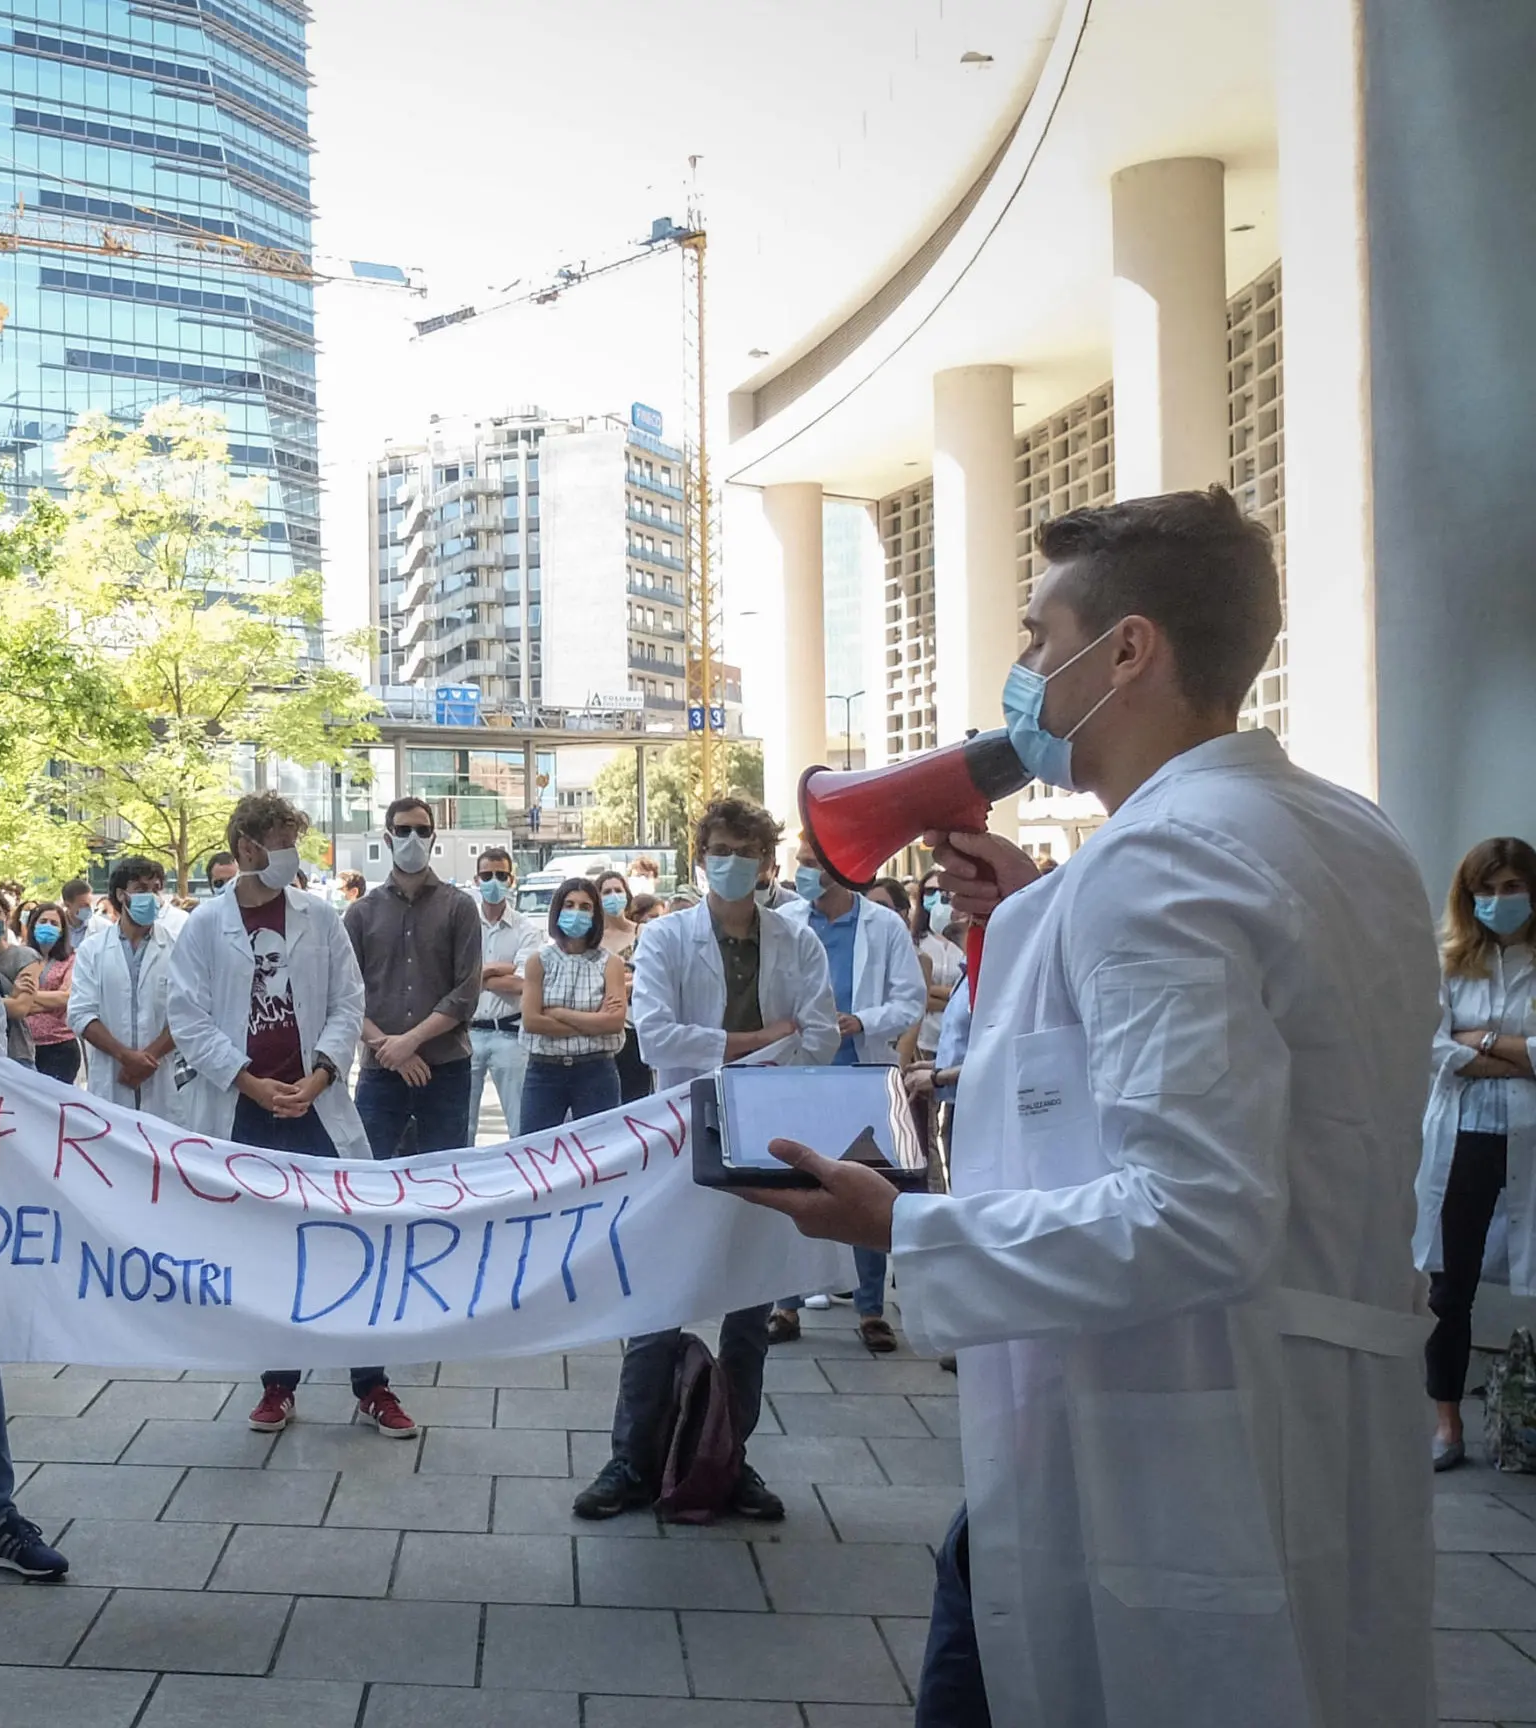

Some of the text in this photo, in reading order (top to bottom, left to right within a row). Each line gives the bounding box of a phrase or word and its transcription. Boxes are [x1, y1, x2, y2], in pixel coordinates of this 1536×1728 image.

[692, 711, 702, 726] 3
[712, 710, 722, 726] 3
[78, 1240, 233, 1306] NOSTRI
[290, 1196, 632, 1326] DIRITTI
